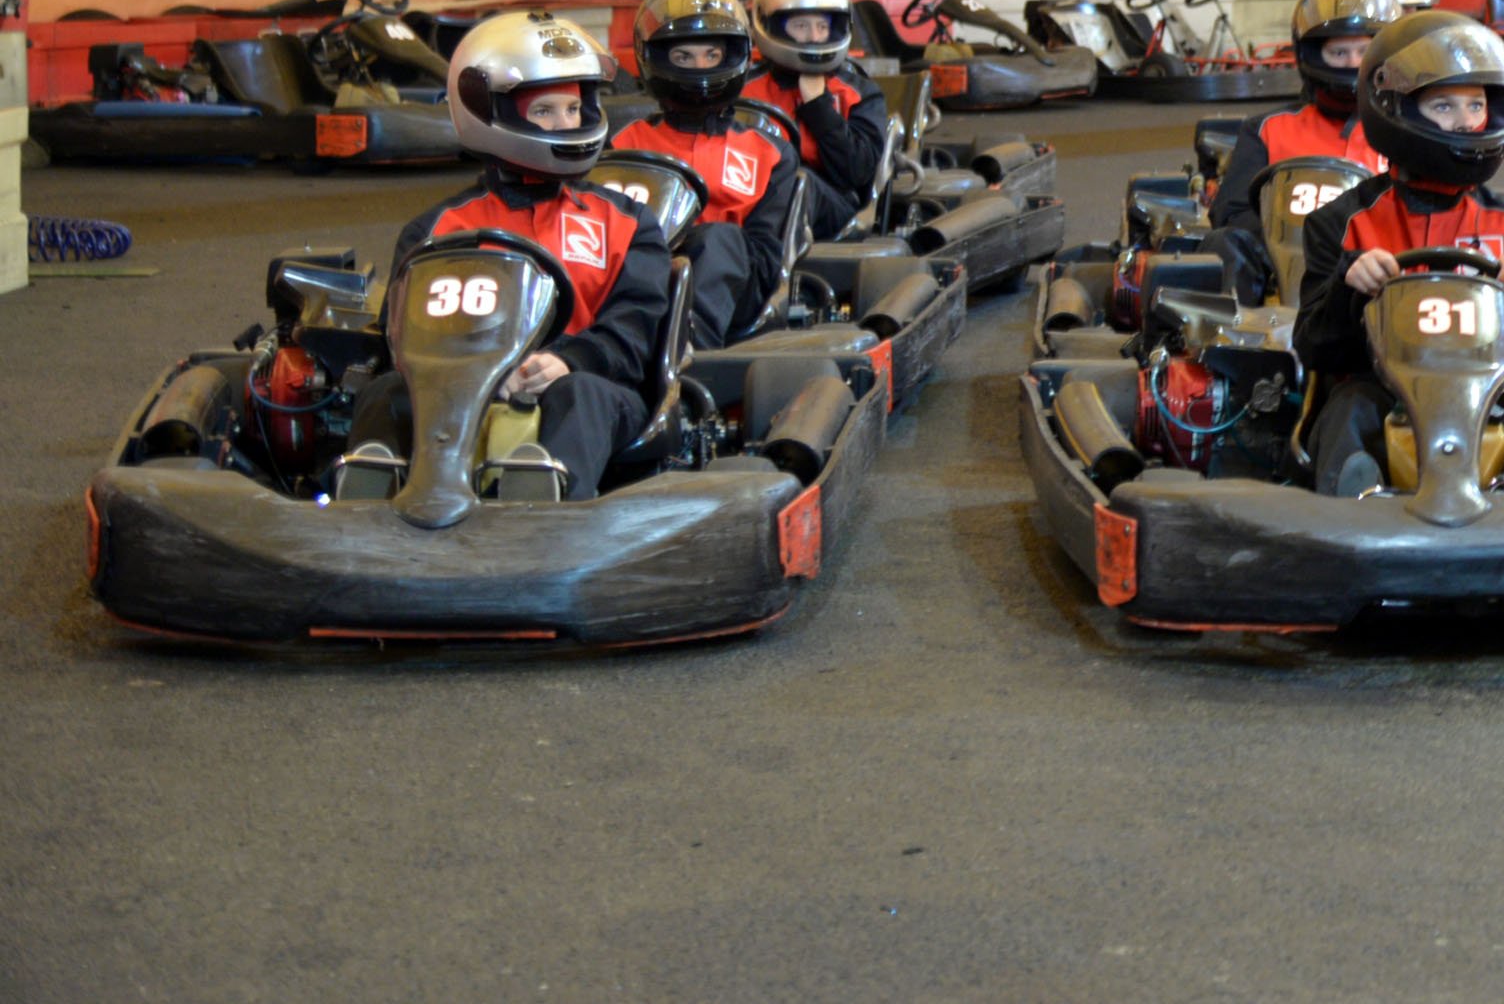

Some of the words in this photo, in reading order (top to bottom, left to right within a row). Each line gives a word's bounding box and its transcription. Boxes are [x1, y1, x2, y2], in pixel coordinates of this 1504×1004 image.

[1289, 182, 1344, 216] 35
[426, 275, 498, 317] 36
[1417, 296, 1477, 336] 31
